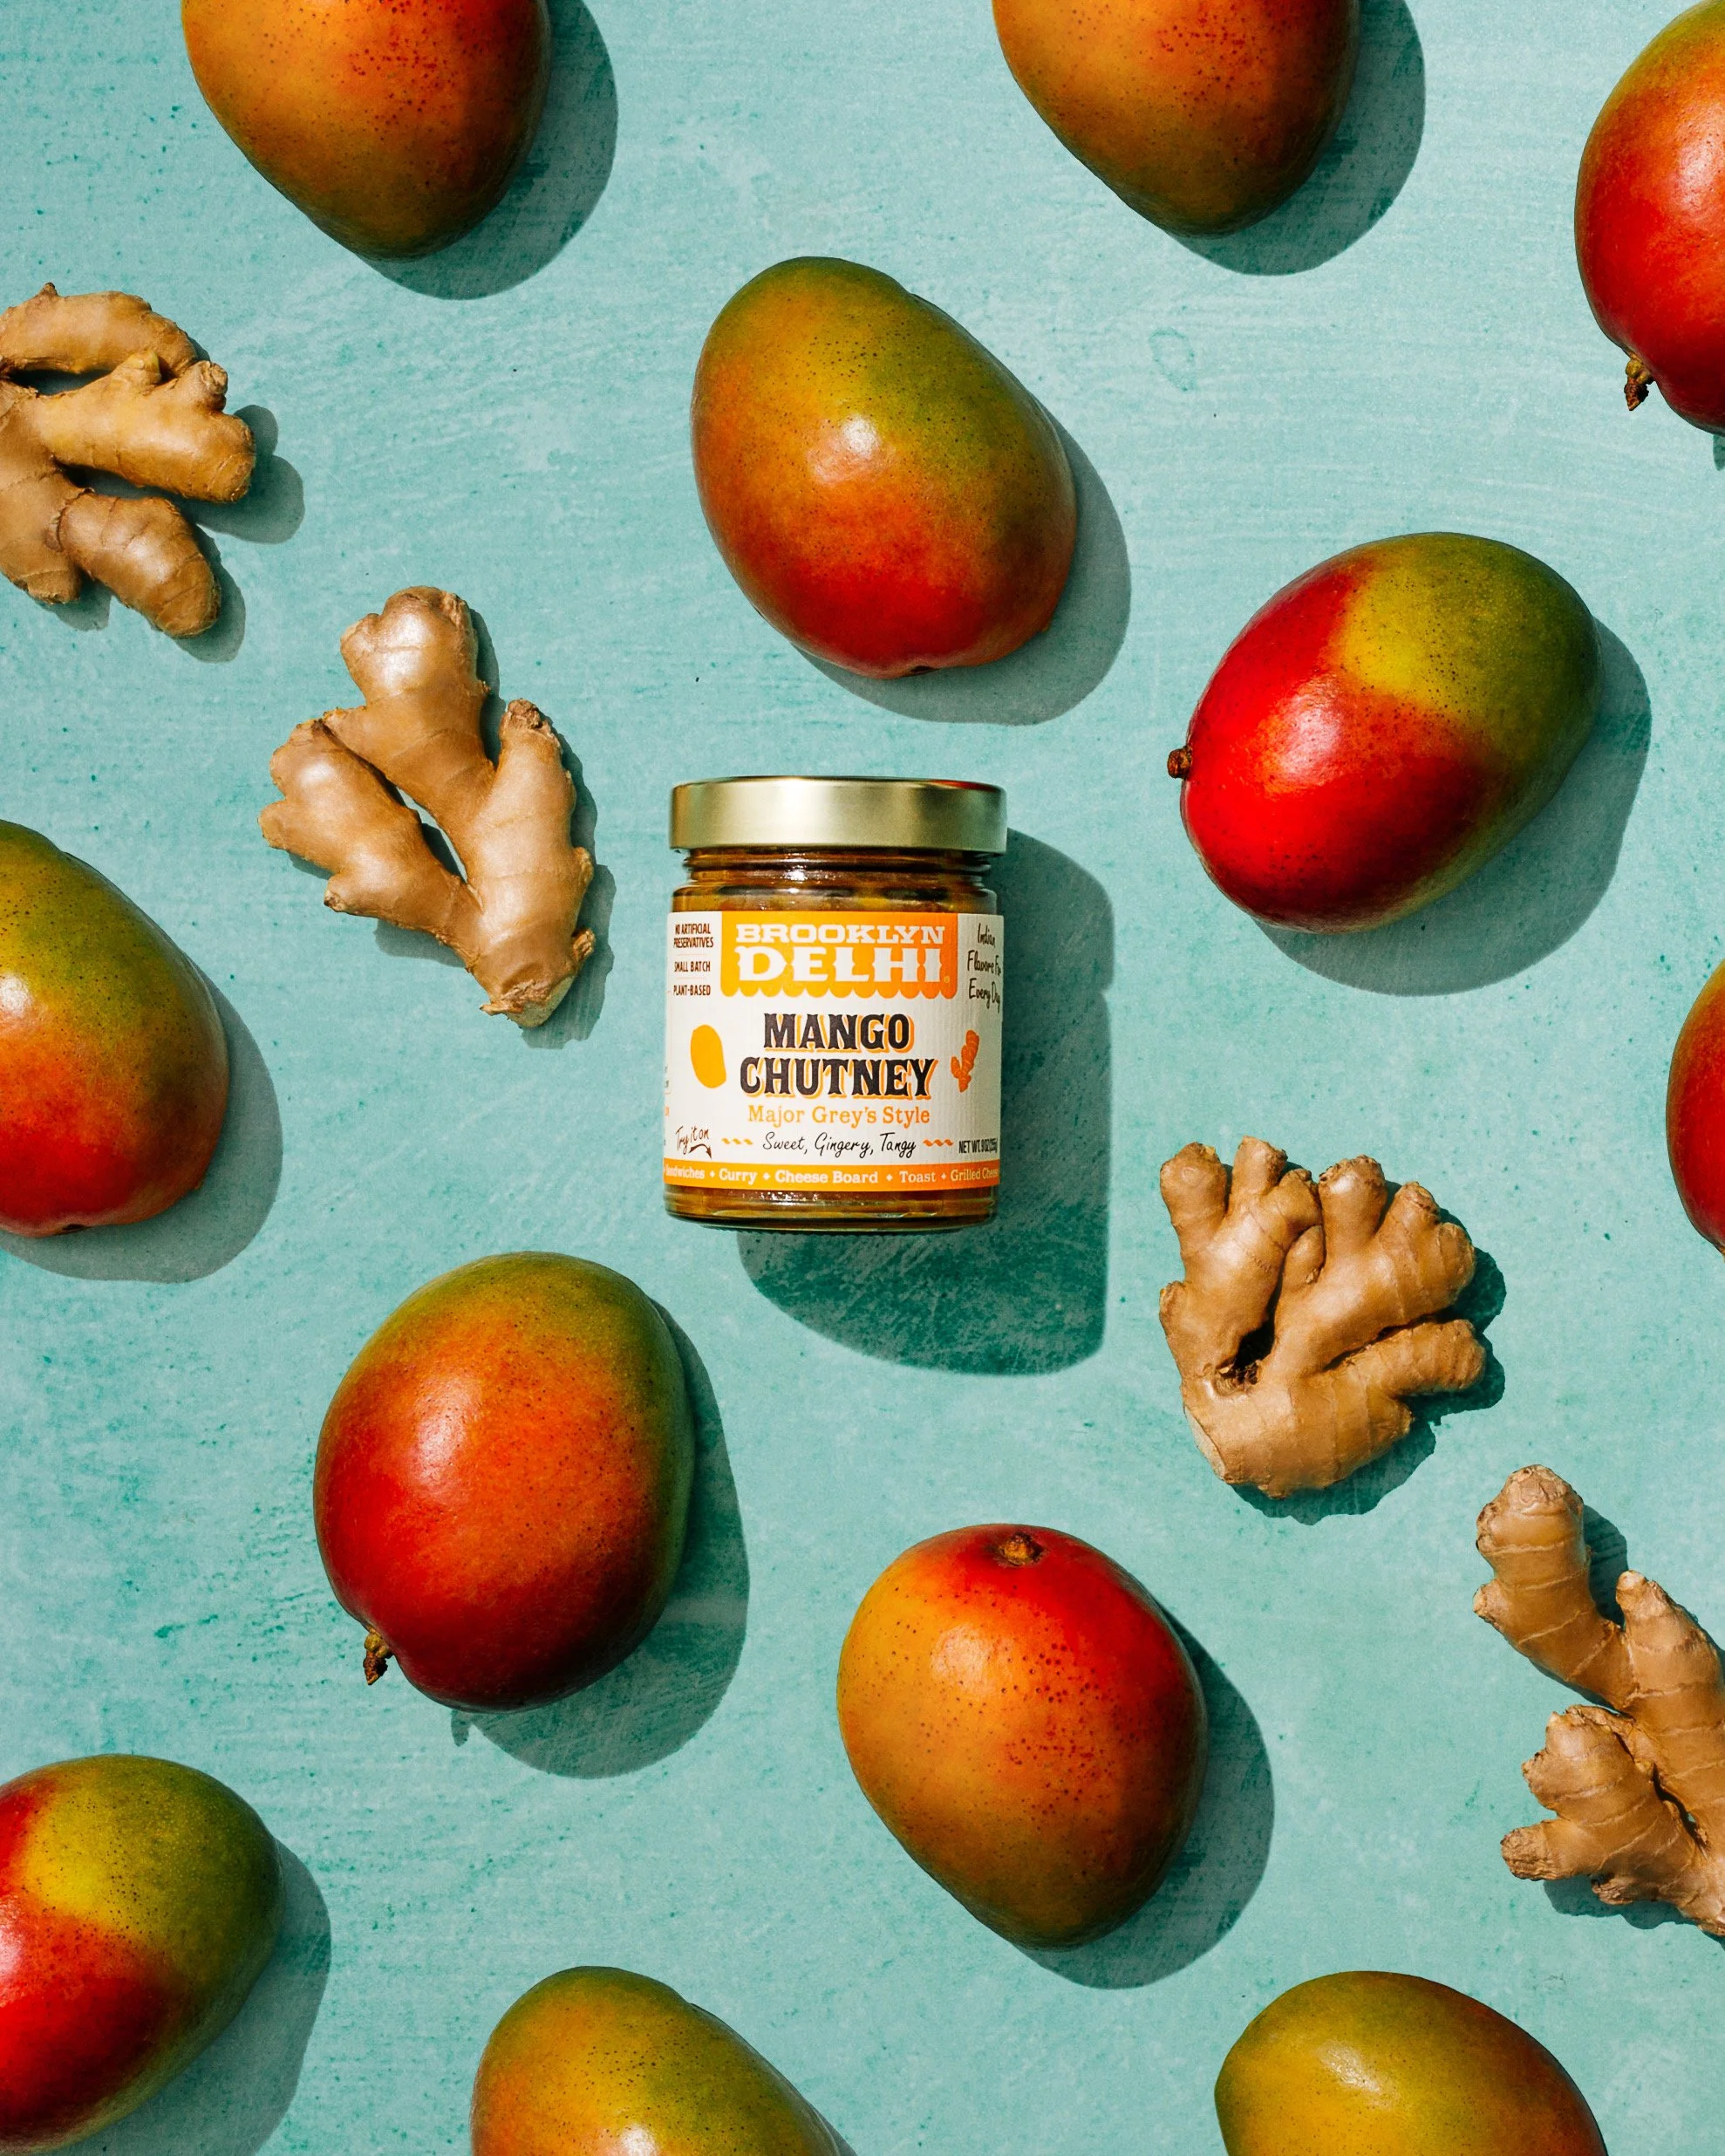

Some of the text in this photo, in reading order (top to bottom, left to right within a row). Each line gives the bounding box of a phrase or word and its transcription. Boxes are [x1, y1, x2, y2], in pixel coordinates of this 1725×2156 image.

[681, 924, 711, 934] ARTIFICIAL
[736, 924, 944, 945] BROOKLYN
[674, 937, 714, 948] PRESERVATIVES
[674, 961, 711, 972] SMALL BATCH
[734, 945, 943, 983] DELHI
[673, 985, 712, 995] PLANT-BASED
[764, 1013, 915, 1054] MANGO
[740, 1056, 938, 1100] CHUTNEY
[748, 1105, 931, 1129] Major Grey's Style
[675, 1126, 688, 1155] Try
[699, 1129, 710, 1140] on
[762, 1131, 917, 1159] Sweet, Gingery, Tangy
[959, 1140, 971, 1153] NET
[719, 1168, 757, 1185] Curry
[774, 1170, 828, 1184] Cheese
[832, 1170, 878, 1184] Board
[899, 1170, 936, 1183] Toast
[951, 1168, 981, 1181] Grilled
